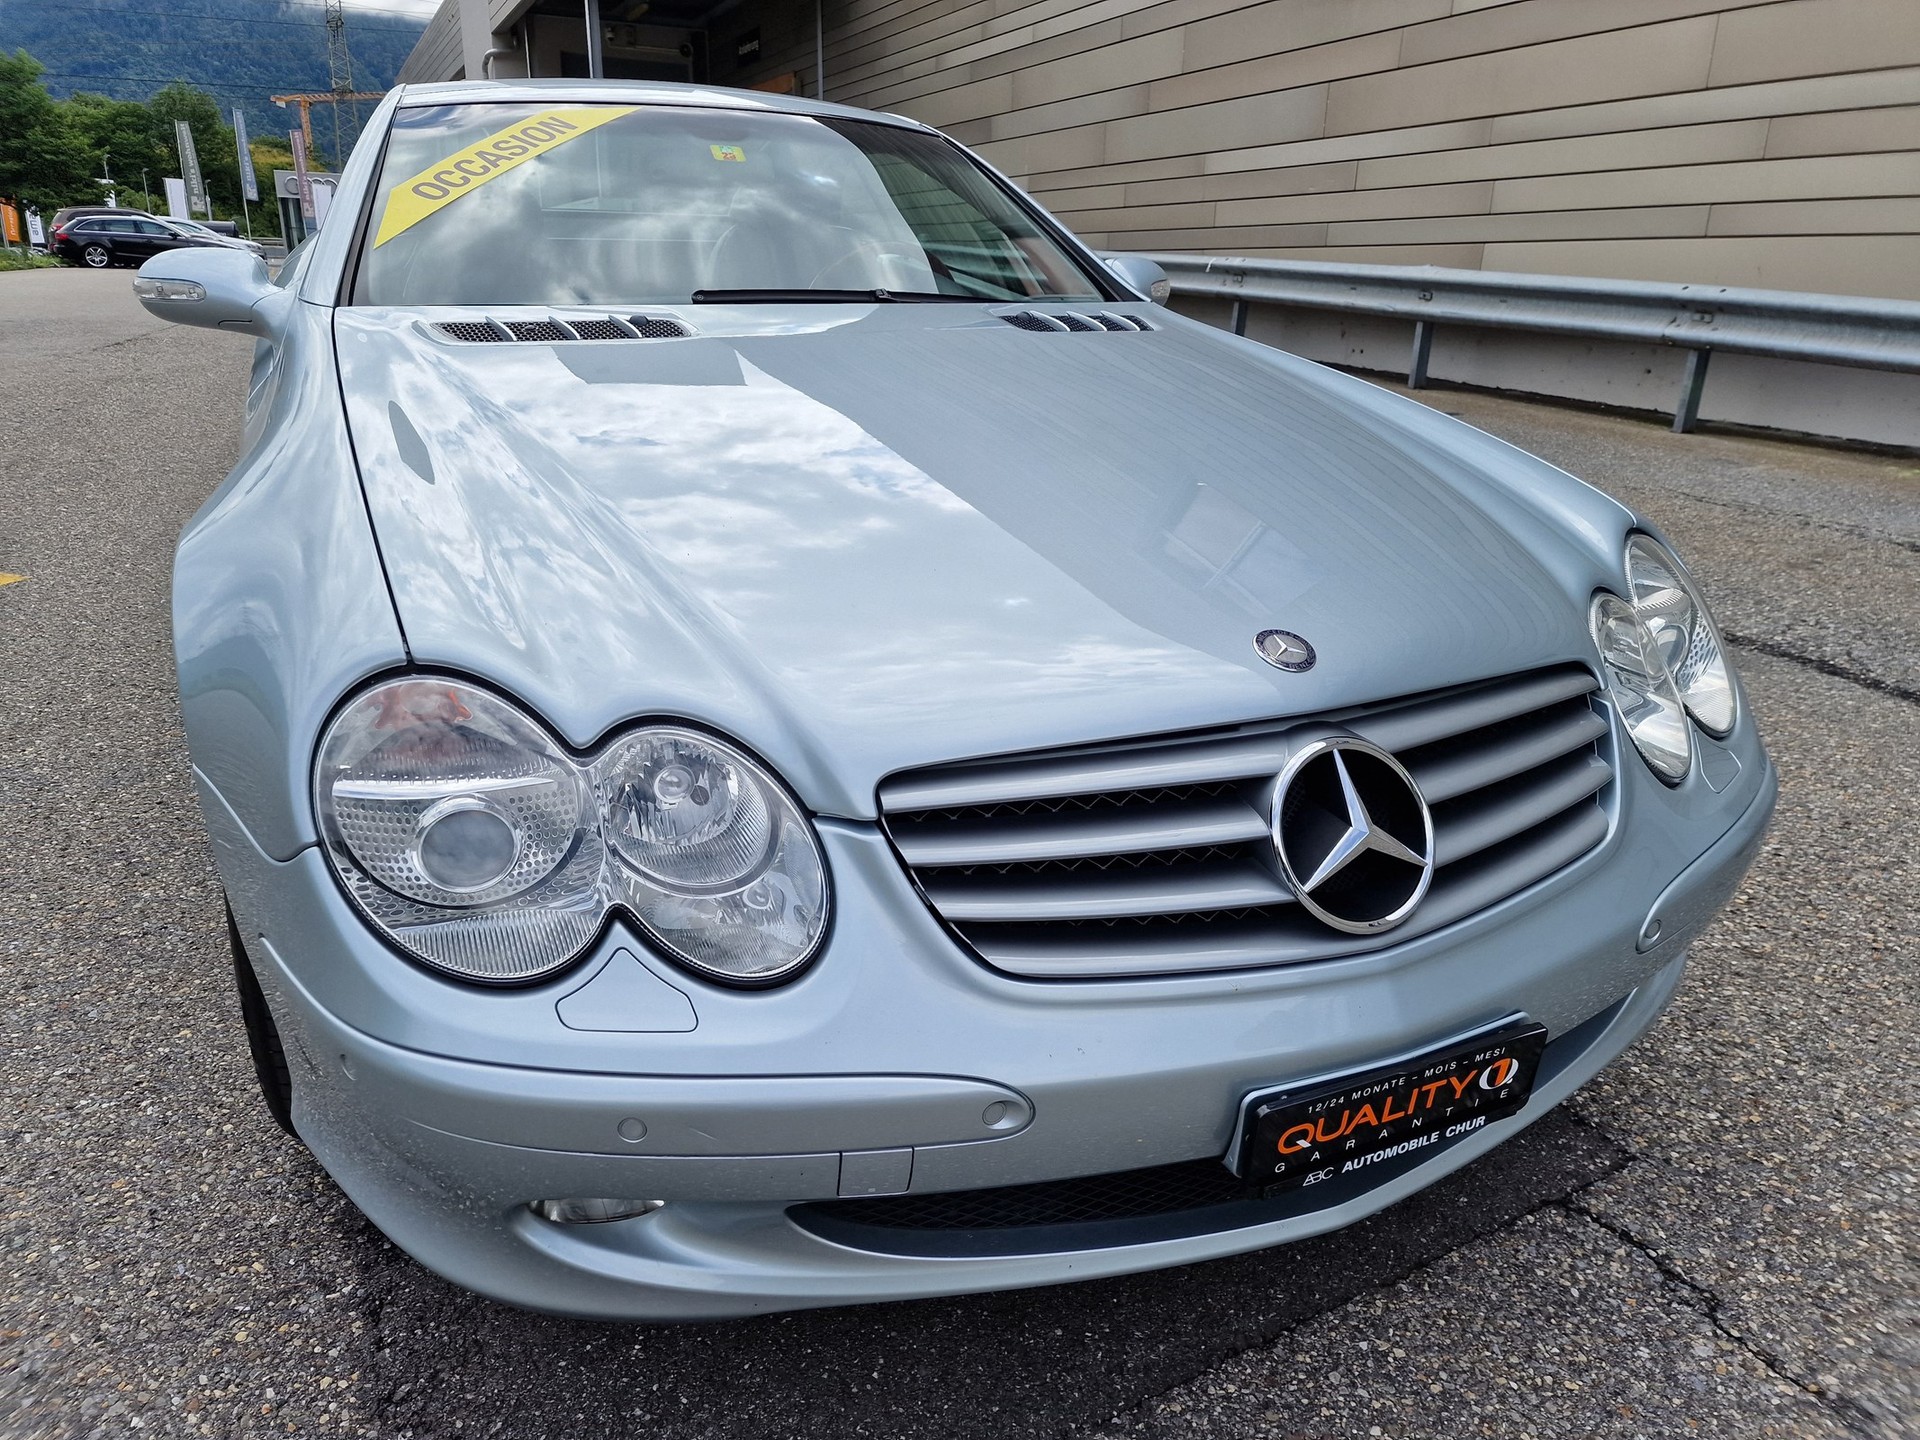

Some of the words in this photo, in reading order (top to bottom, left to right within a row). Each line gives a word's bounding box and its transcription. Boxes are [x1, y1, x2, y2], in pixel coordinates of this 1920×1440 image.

[411, 116, 578, 201] OCCASION
[1277, 1069, 1478, 1155] QUALITY
[1308, 1096, 1345, 1114] 12/24
[1351, 1076, 1407, 1101] MONATE
[1424, 1061, 1458, 1078] MOIS
[1474, 1047, 1506, 1063] MESI
[1341, 1131, 1440, 1174] AUTOMOBILE
[1445, 1115, 1486, 1138] CHUR
